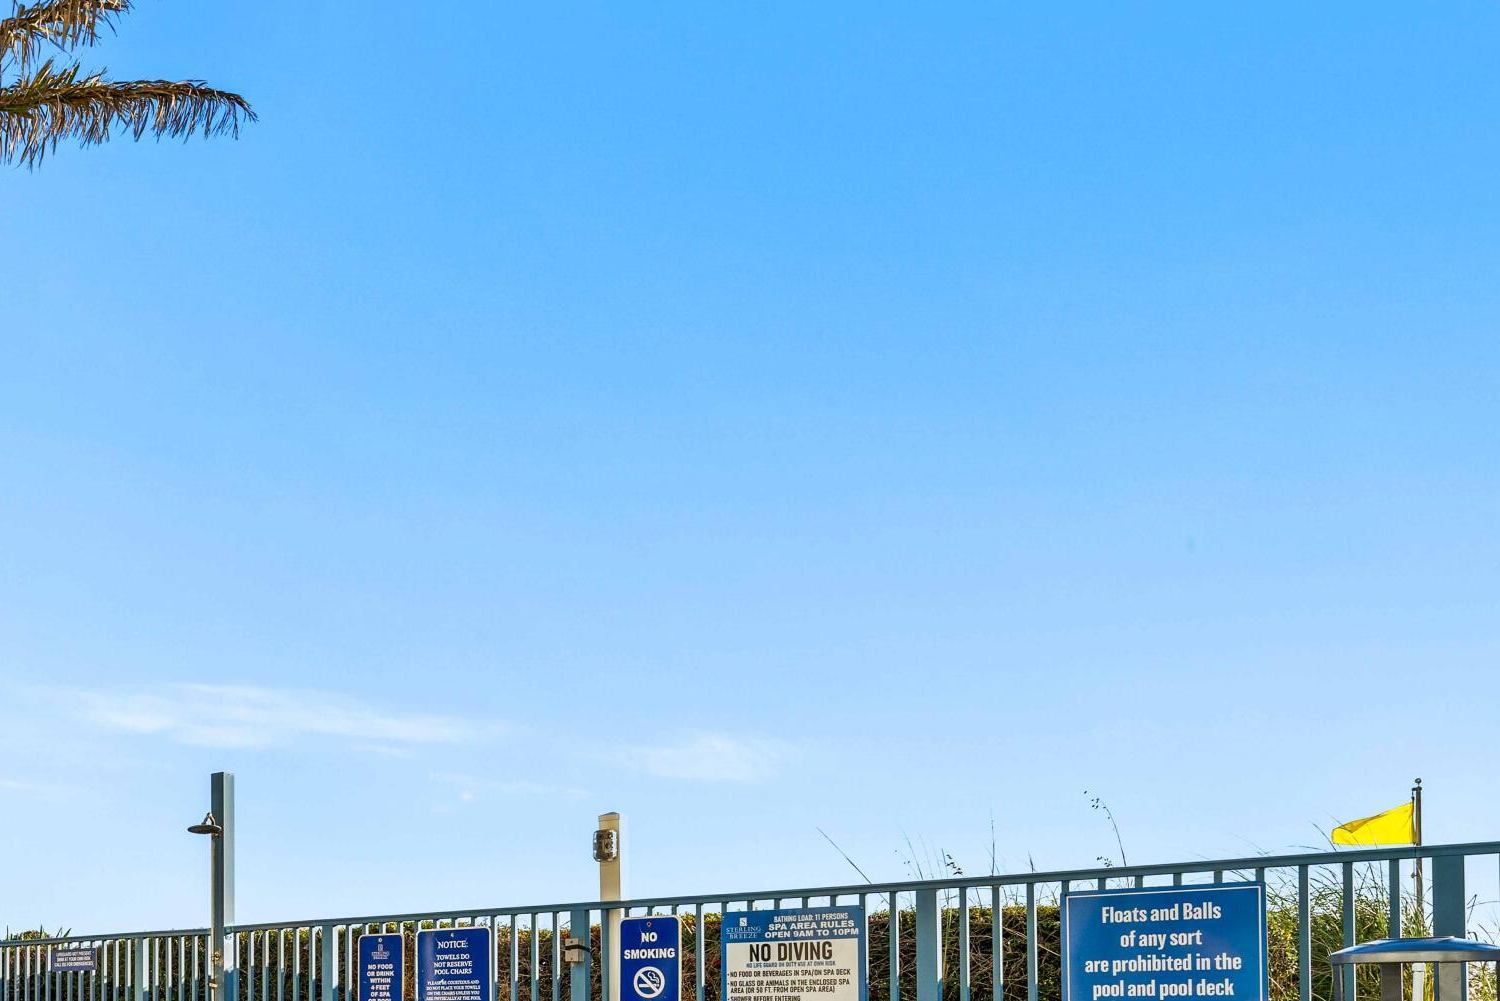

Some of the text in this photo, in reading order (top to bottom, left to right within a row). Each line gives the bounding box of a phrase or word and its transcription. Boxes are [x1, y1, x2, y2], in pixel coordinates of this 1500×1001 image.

[1102, 902, 1222, 924] Floats and Balls
[820, 920, 854, 928] RULES
[438, 940, 468, 948] NOTICE:
[641, 932, 657, 942] NO
[1120, 930, 1202, 950] of any sort
[624, 948, 675, 959] SMOKING
[750, 941, 832, 962] NO DIVING
[1085, 953, 1242, 976] are prohibited in the
[1093, 978, 1234, 1000] pool and pool deck
